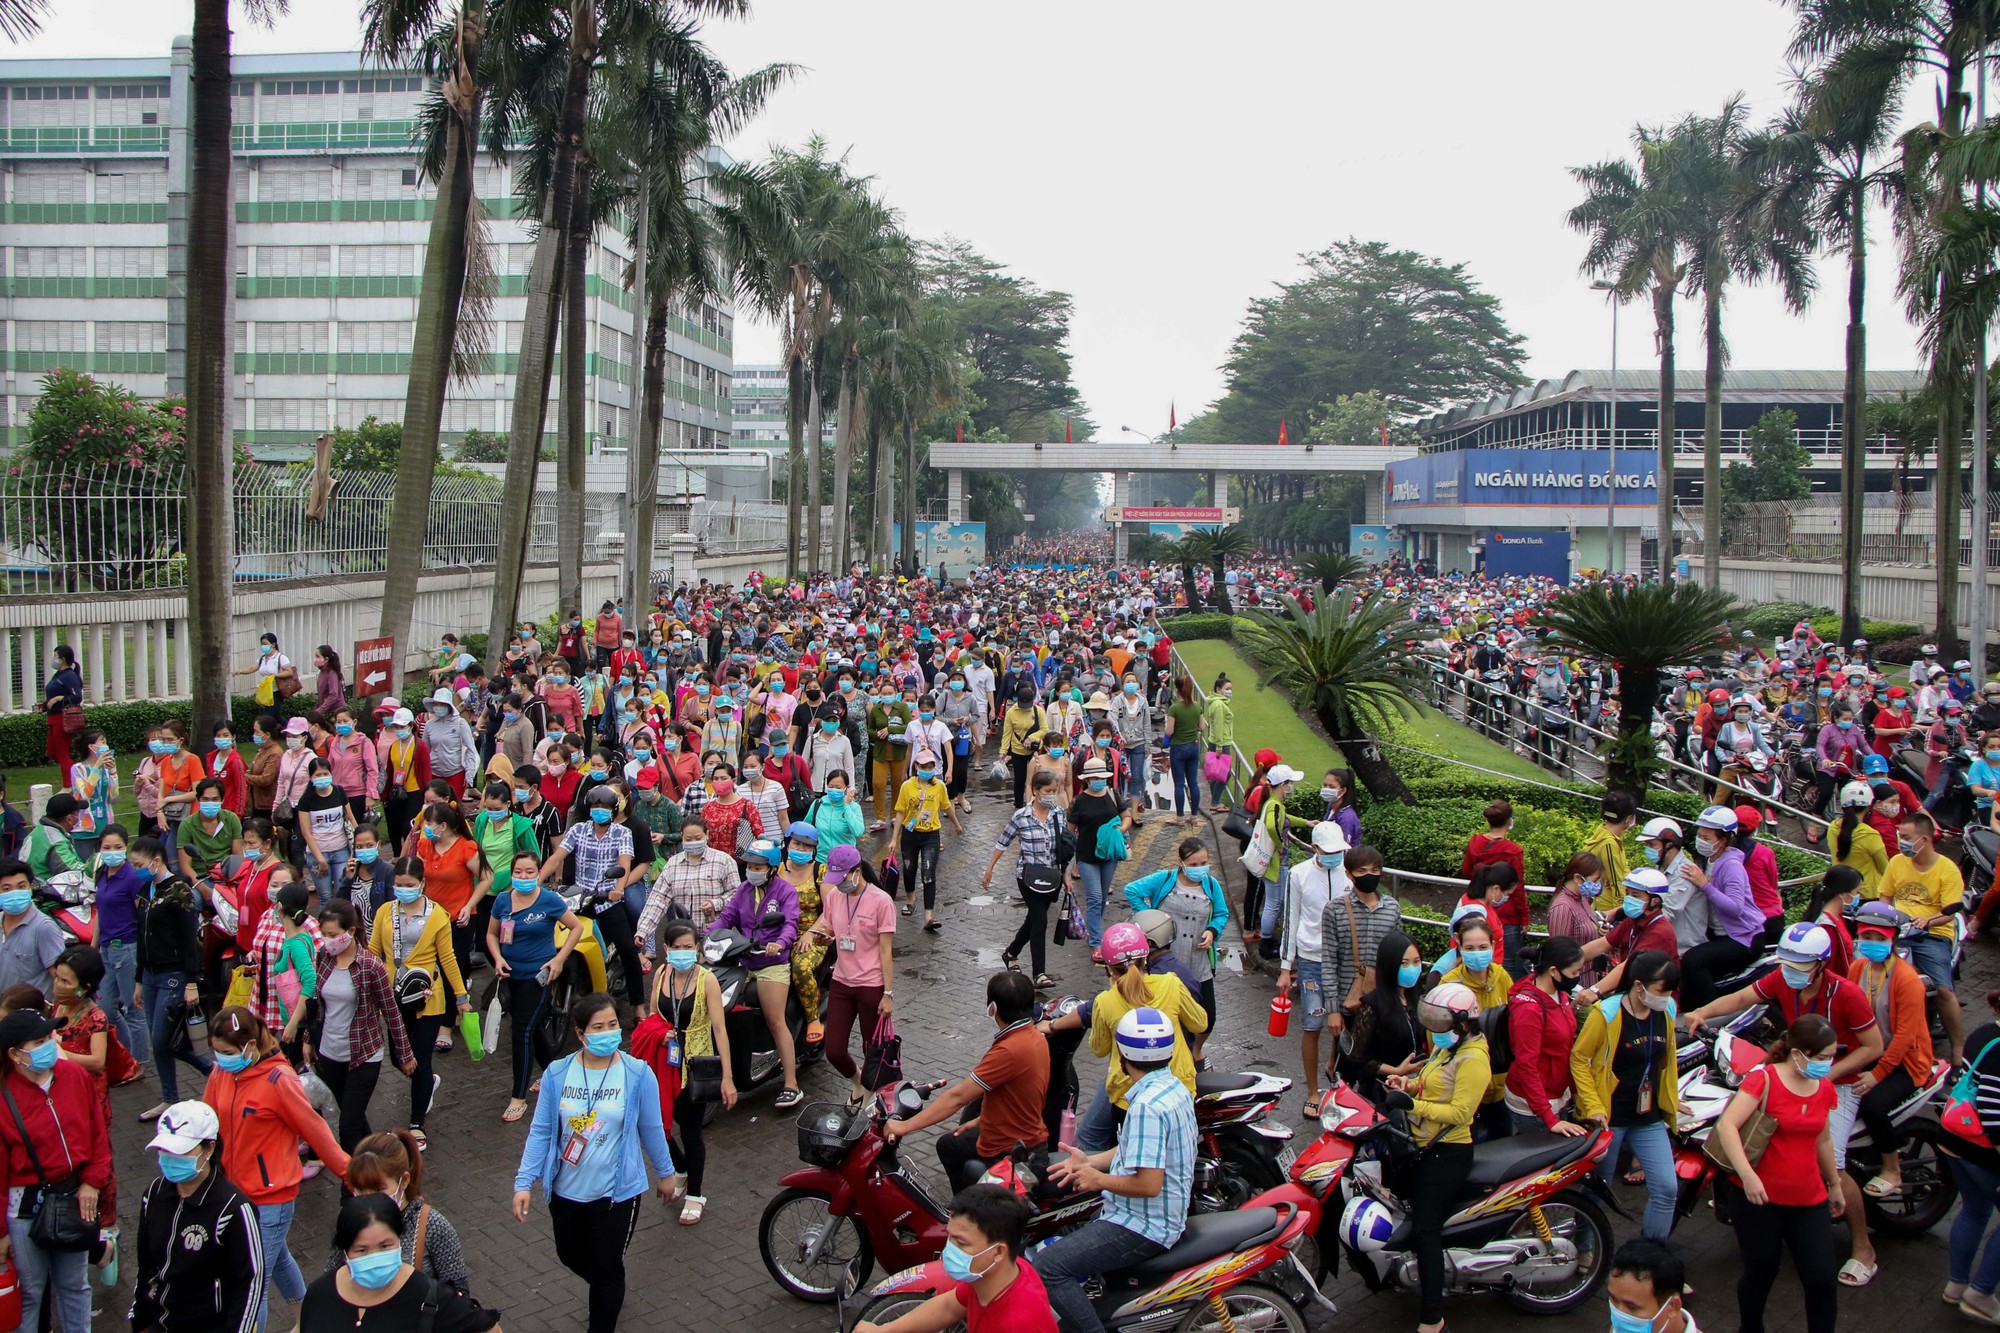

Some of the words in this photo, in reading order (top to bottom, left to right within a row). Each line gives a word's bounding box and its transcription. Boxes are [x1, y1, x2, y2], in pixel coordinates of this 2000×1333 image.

[1475, 469, 1528, 487] NGÂN
[1532, 469, 1583, 488] HÀNG
[1643, 470, 1657, 488] Á
[316, 812, 342, 823] FILA
[562, 1085, 589, 1100] MOUSE
[591, 1088, 621, 1101] HAPPY
[185, 1232, 203, 1251] 09
[1140, 1308, 1174, 1321] HONDA
